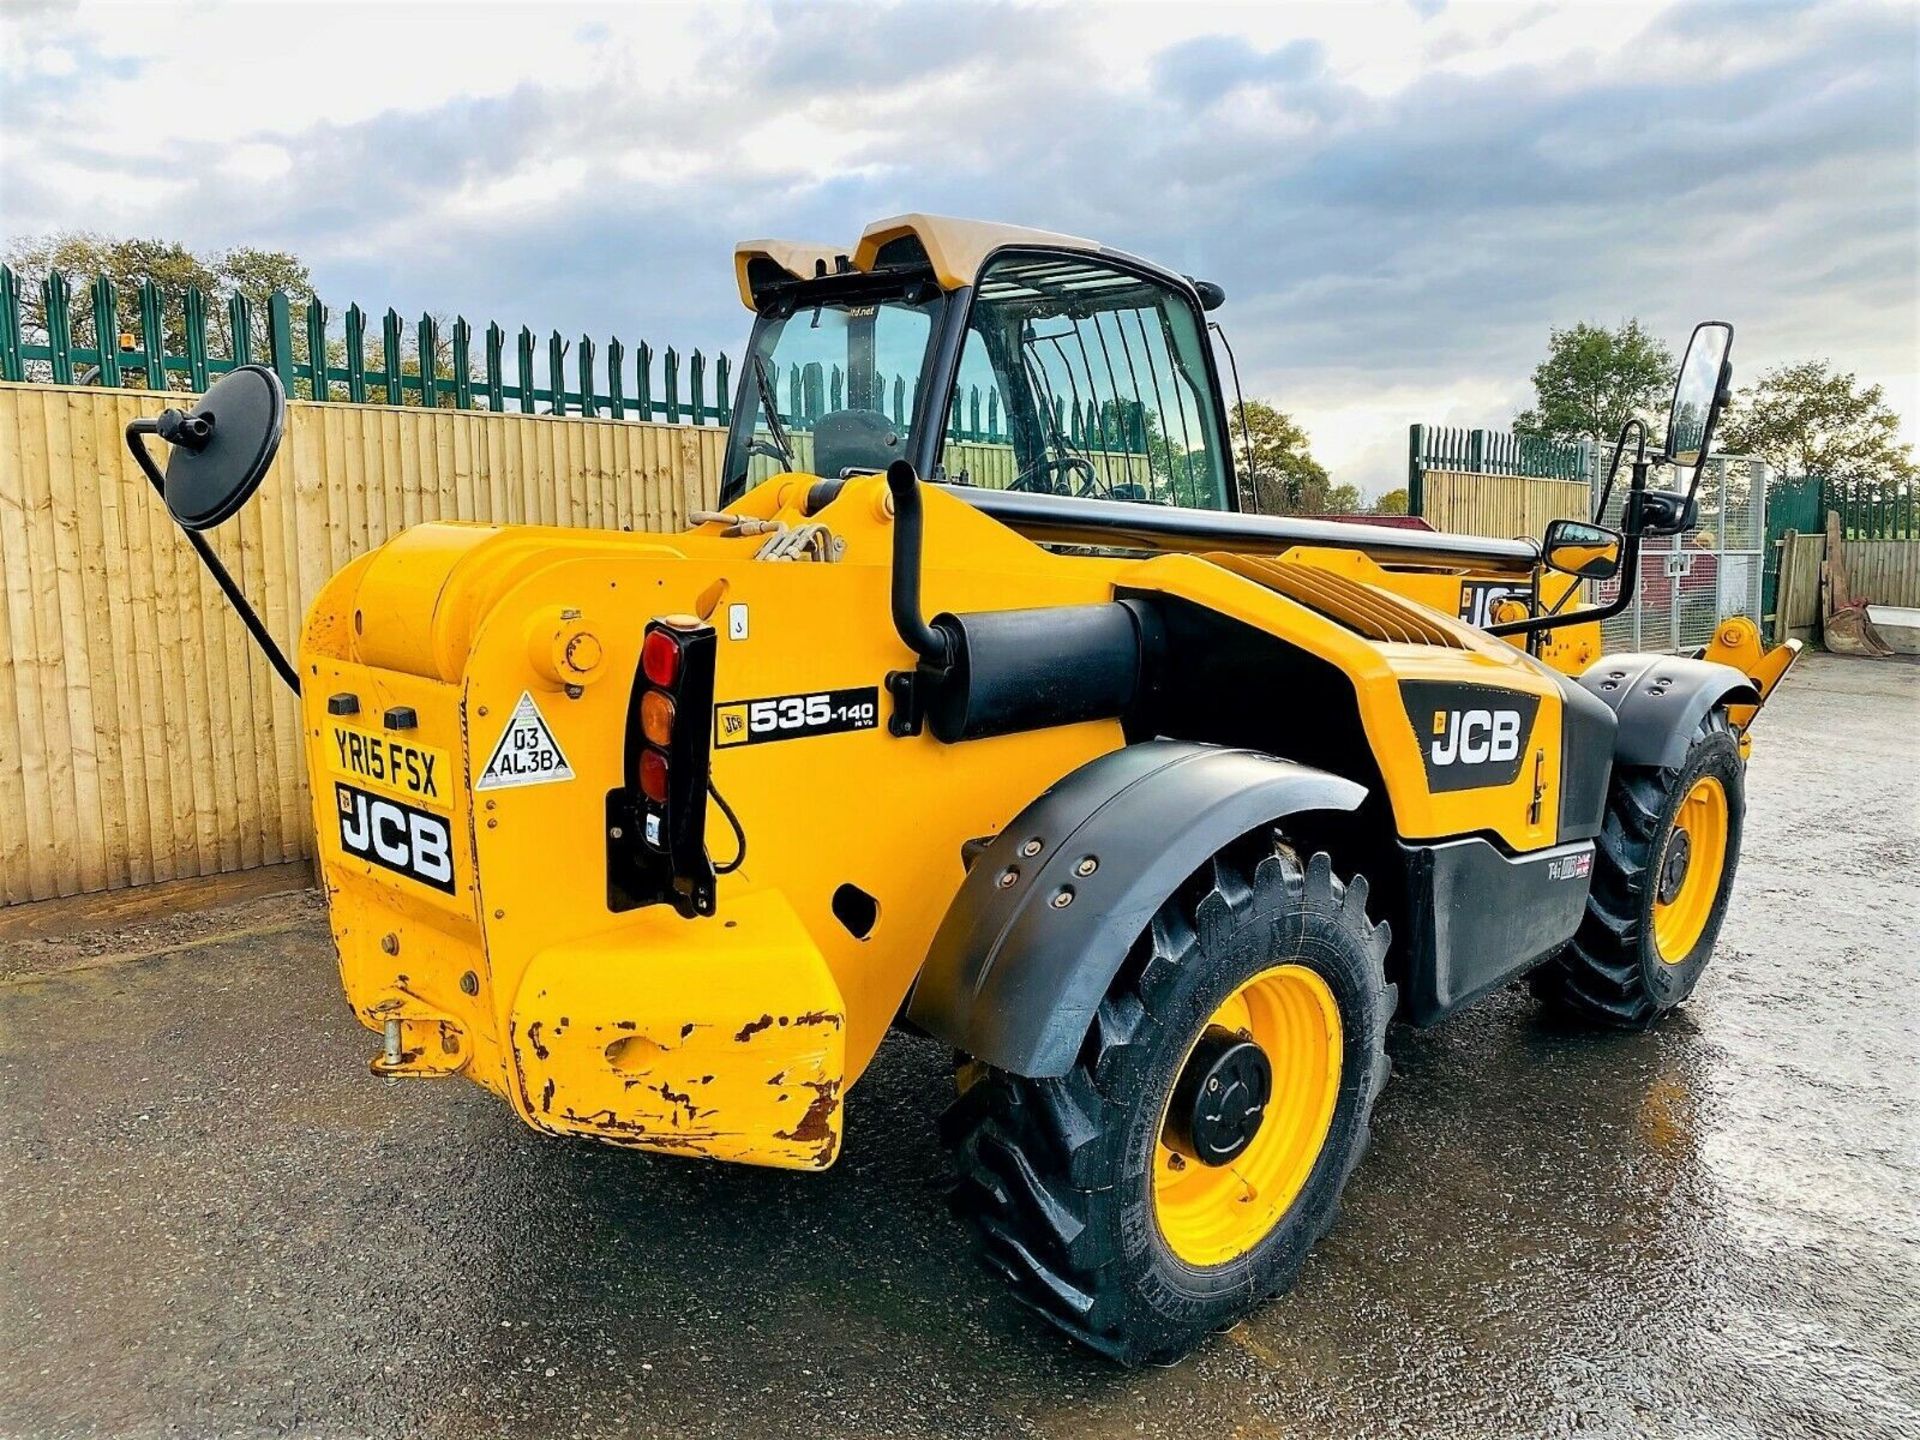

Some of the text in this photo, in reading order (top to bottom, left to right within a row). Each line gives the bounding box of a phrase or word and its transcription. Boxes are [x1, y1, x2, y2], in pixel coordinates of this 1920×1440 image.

[1460, 587, 1533, 629] JC
[750, 694, 874, 733] 535-140
[1431, 709, 1521, 766] JCB
[335, 728, 438, 798] YR15 FSX
[499, 749, 553, 776] AL3B
[342, 794, 451, 883] JCB
